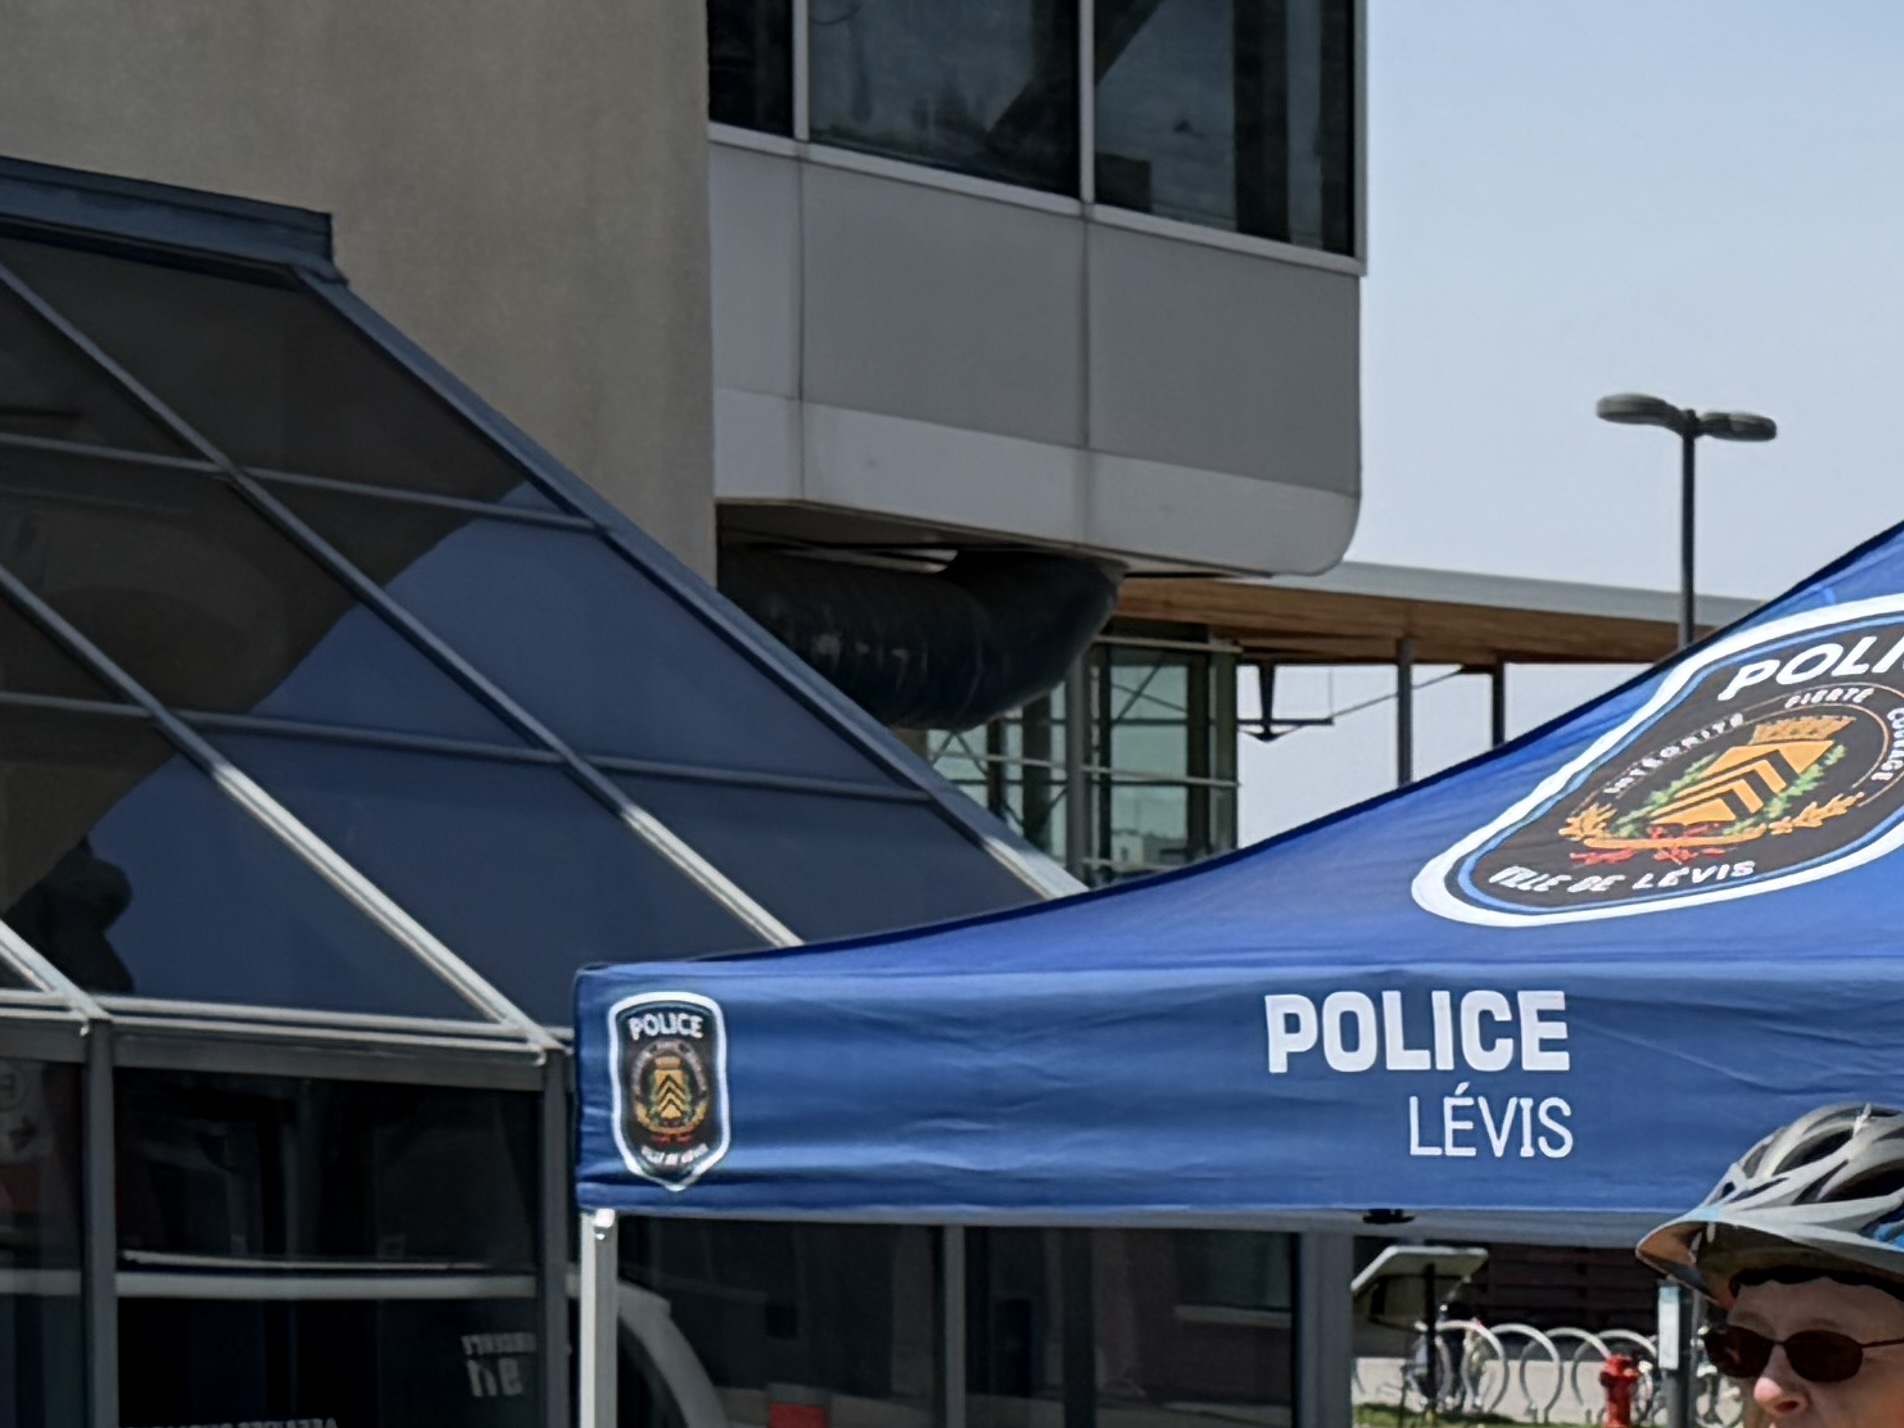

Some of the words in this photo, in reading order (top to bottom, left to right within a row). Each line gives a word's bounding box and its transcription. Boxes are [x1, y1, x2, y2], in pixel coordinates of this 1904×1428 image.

[628, 1012, 705, 1041] POLICE
[1264, 989, 1571, 1074] POLICE
[1409, 1080, 1574, 1159] LÉVIS
